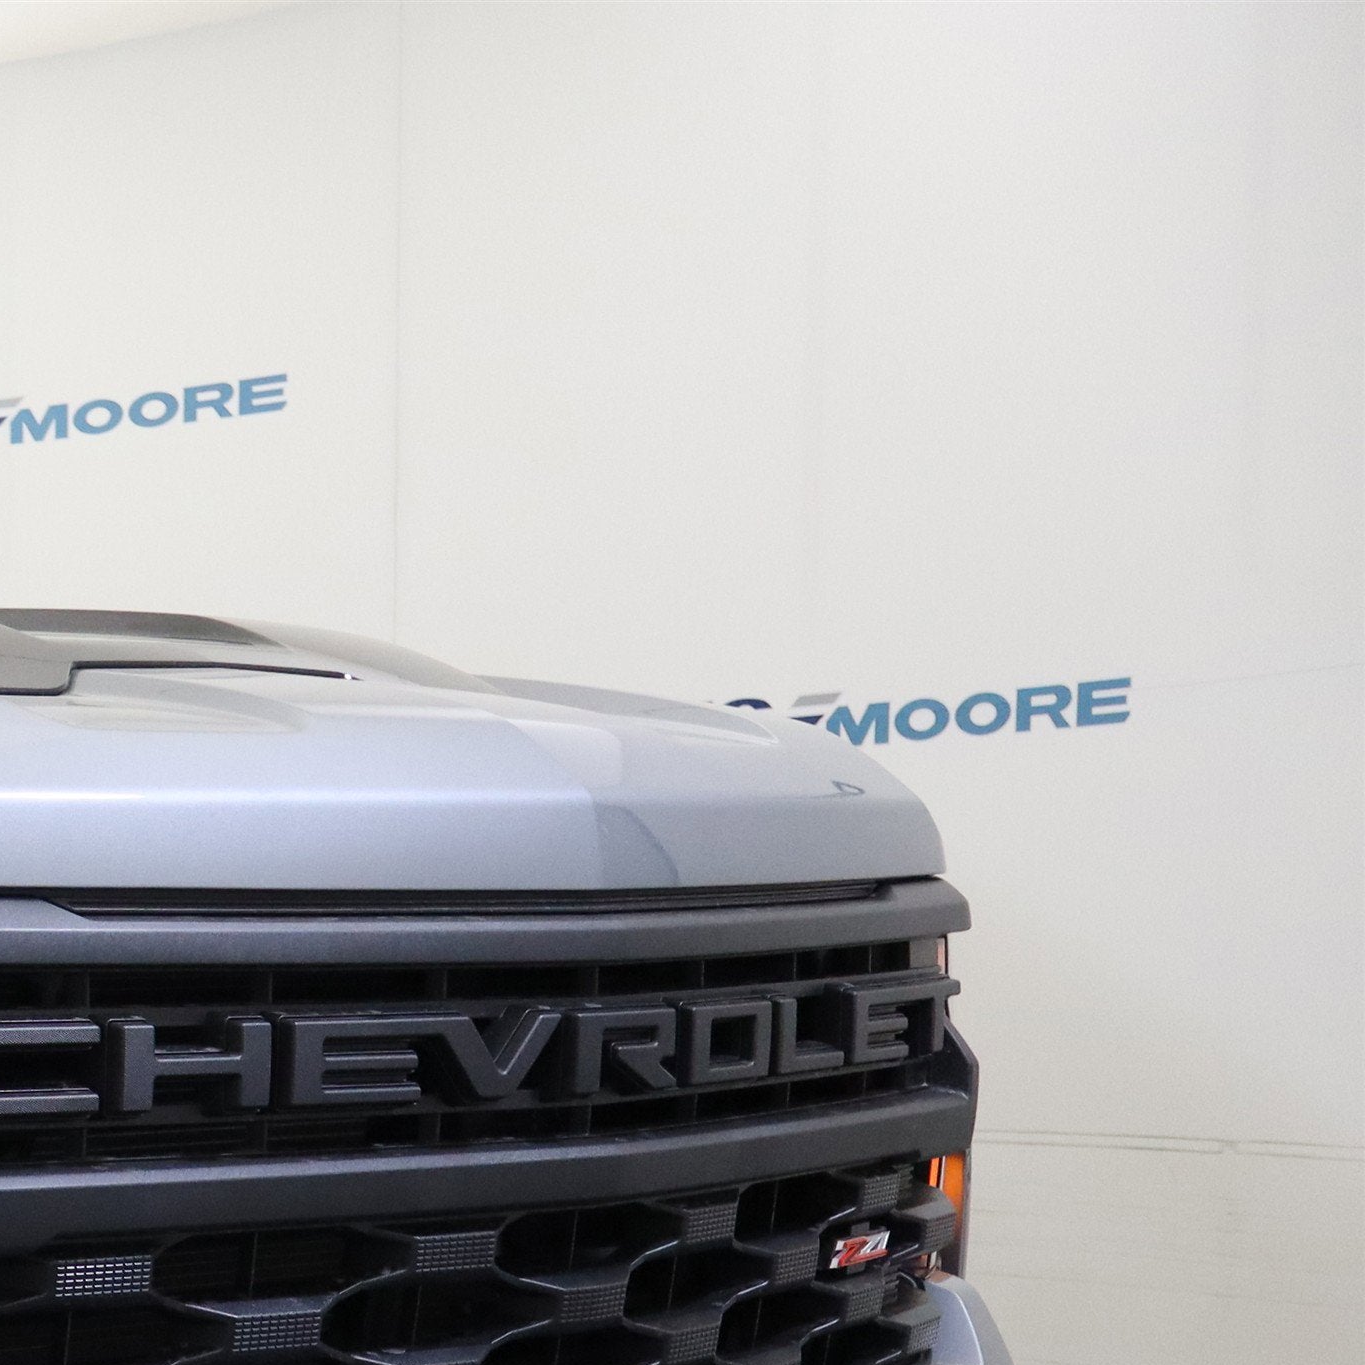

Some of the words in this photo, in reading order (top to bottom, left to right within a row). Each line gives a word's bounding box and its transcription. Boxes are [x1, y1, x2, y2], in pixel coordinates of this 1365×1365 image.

[9, 373, 288, 444] MOORE
[826, 677, 1131, 746] MOORE
[829, 1230, 891, 1269] Z71
